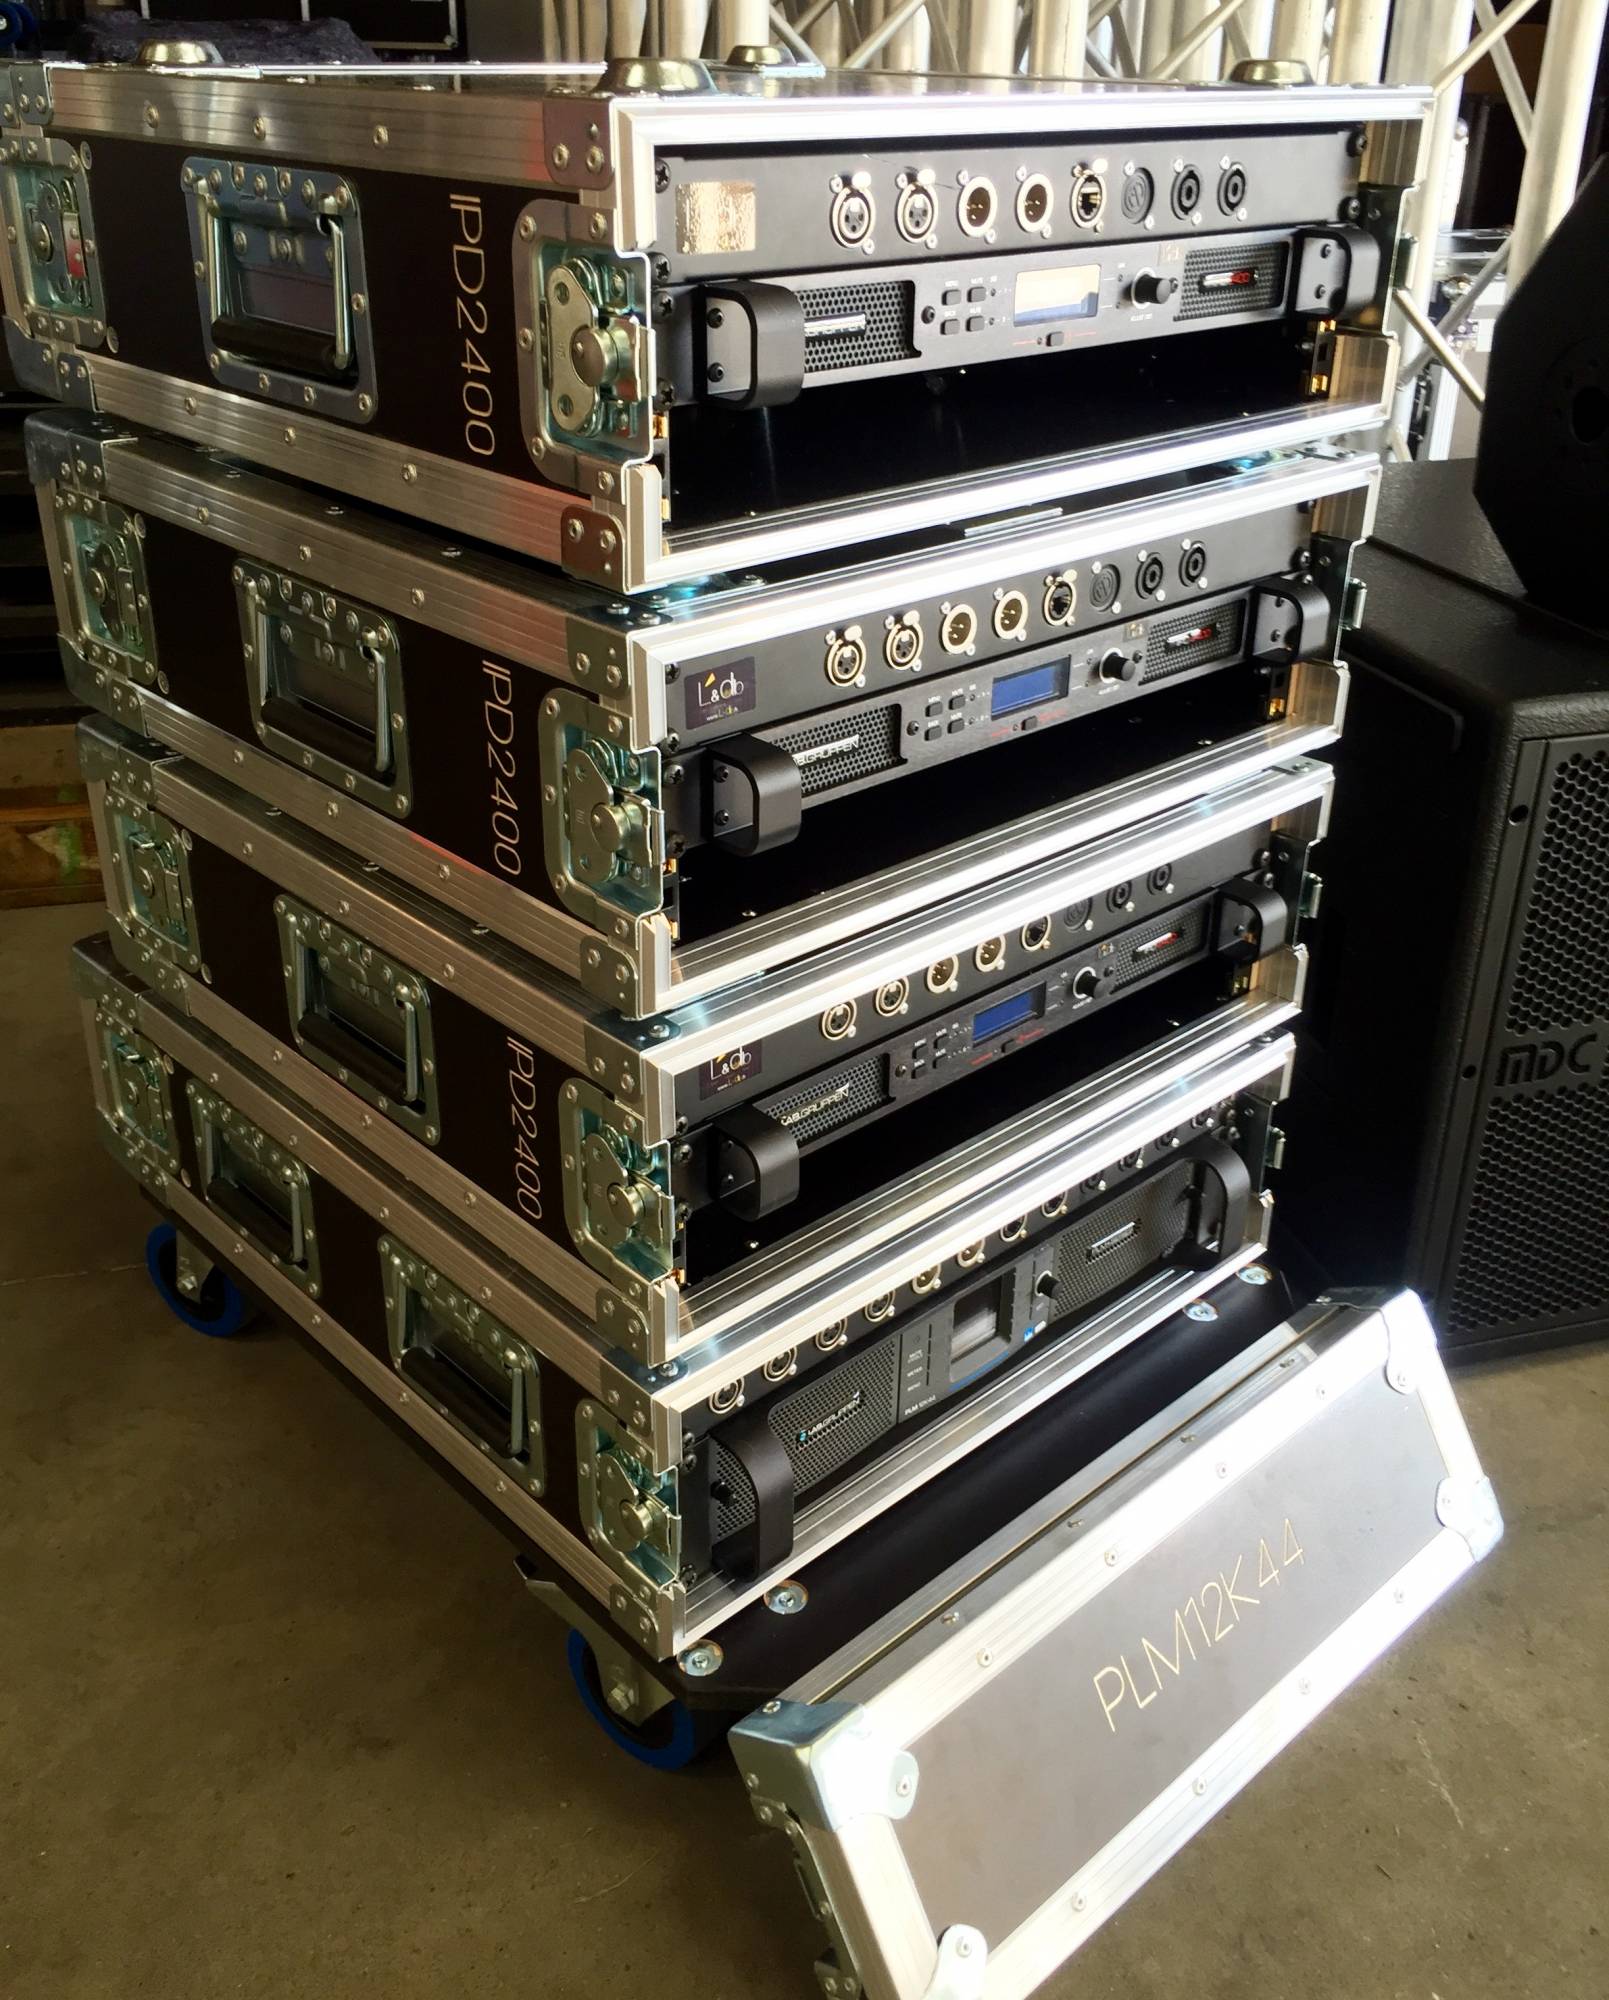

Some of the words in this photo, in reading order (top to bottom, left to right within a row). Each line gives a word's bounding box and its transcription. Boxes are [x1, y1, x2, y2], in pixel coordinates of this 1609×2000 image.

[450, 194, 496, 456] IPD2400
[482, 660, 521, 875] IPD2400
[507, 1036, 543, 1220] IPD2400
[1493, 1033, 1598, 1087] MDC
